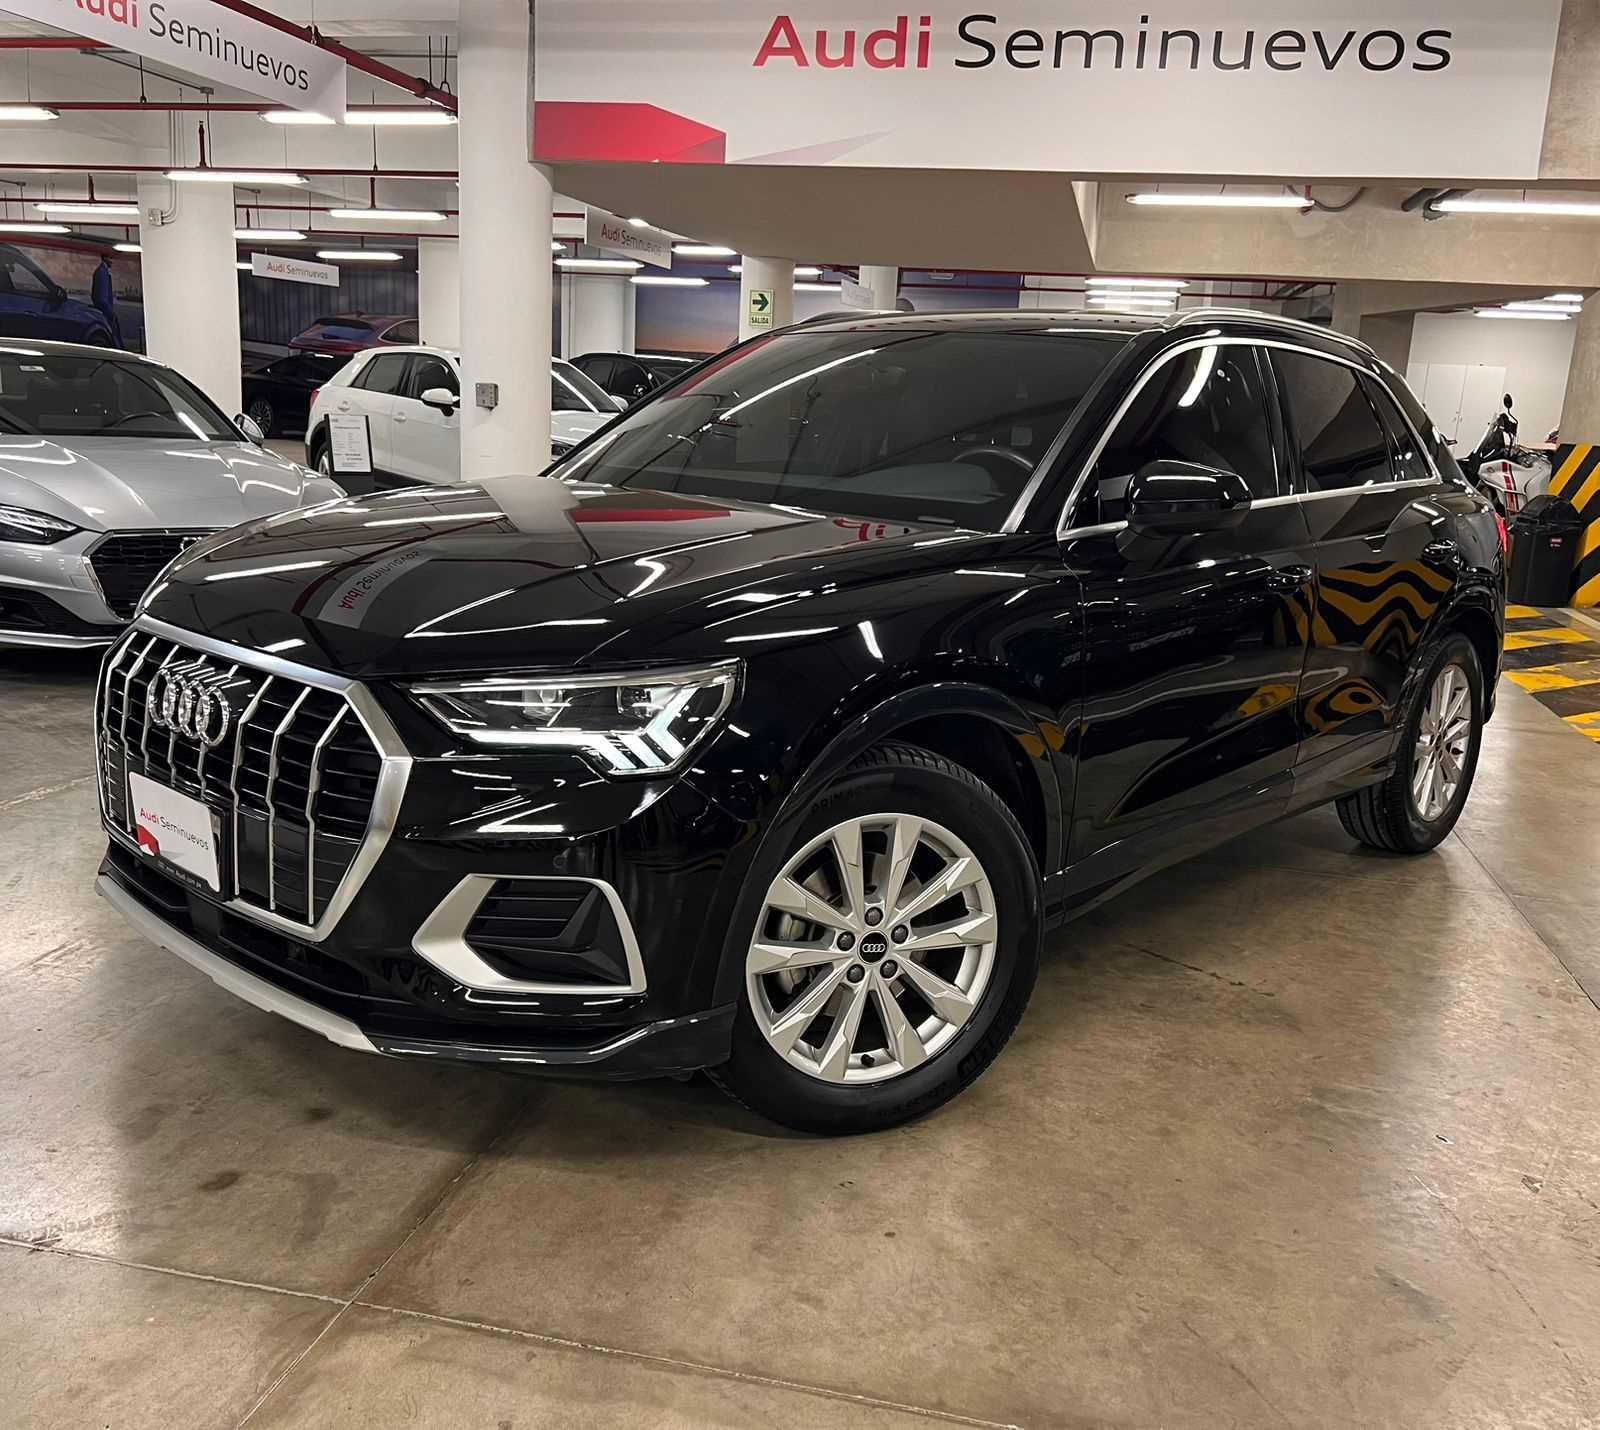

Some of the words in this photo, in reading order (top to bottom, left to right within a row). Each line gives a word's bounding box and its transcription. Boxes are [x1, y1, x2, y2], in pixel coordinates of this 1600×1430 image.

[149, 3, 309, 90] Seminuevos
[752, 15, 931, 68] Audi
[954, 13, 1452, 71] Seminuevos
[601, 224, 620, 241] Audi
[266, 261, 286, 273] Audi
[287, 265, 329, 279] Seminuevos
[140, 807, 160, 825] Audi
[160, 816, 209, 850] Seminuevos
